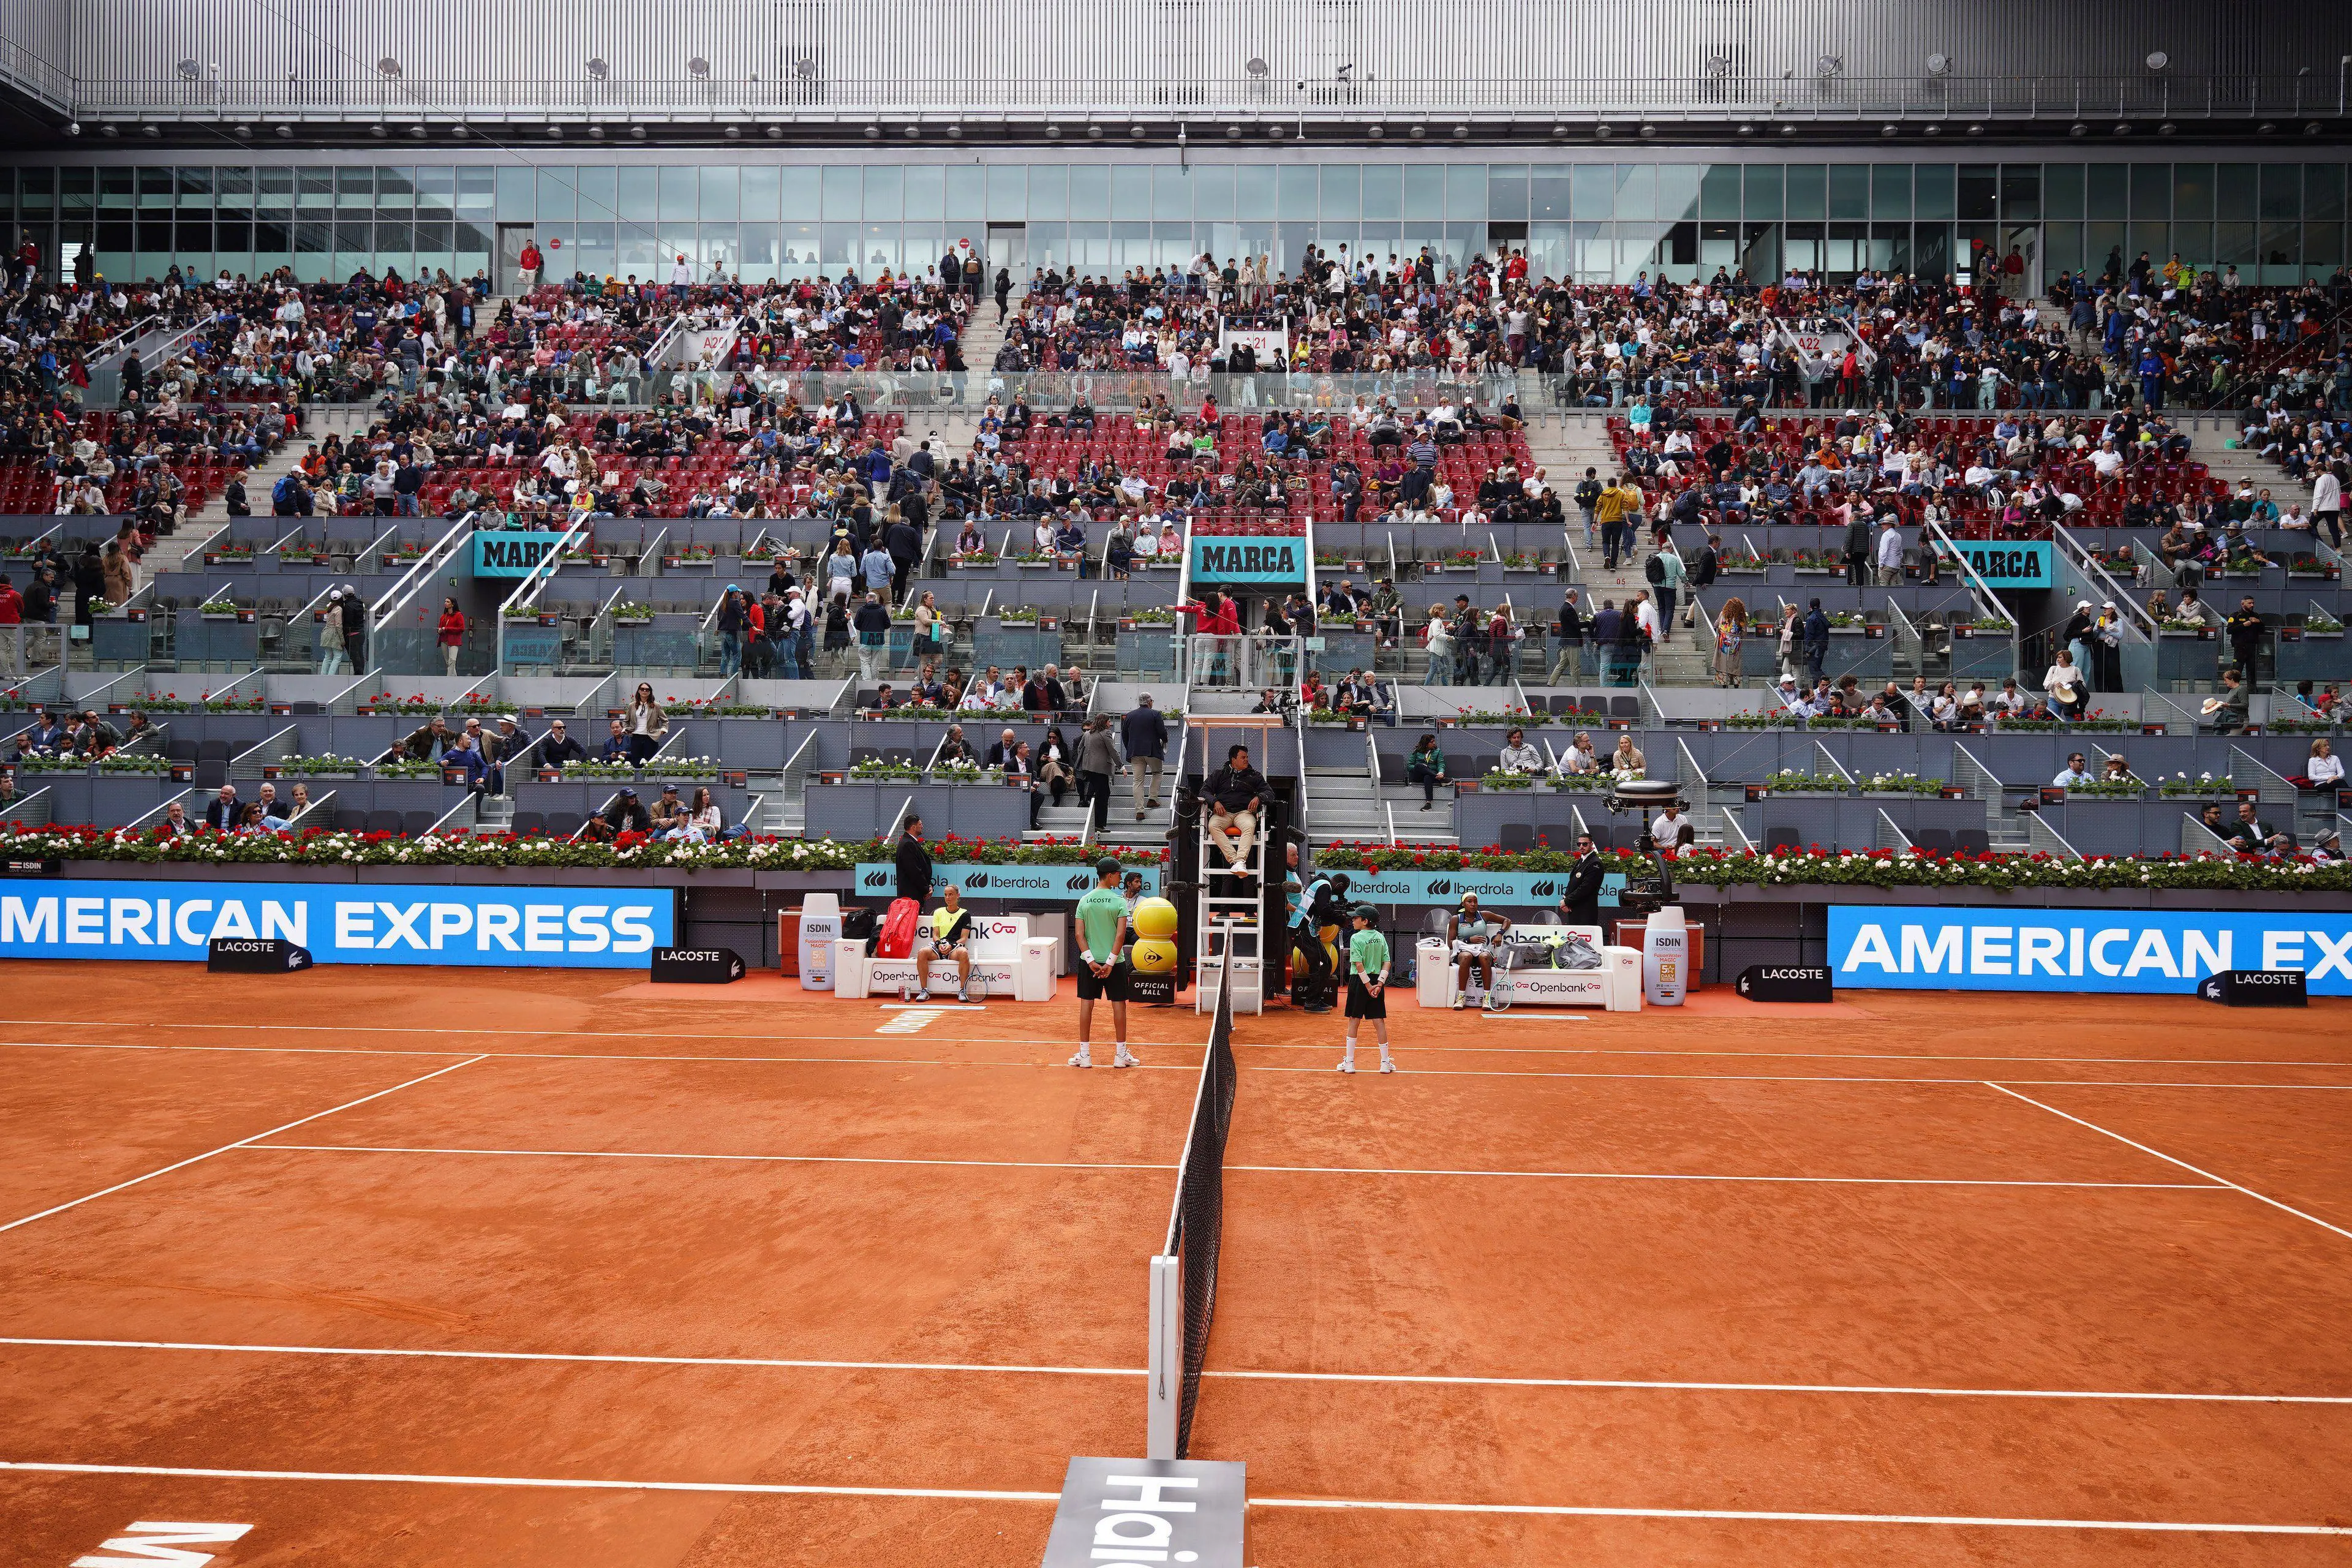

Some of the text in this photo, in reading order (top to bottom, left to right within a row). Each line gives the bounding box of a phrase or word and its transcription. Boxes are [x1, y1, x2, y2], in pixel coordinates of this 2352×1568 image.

[1799, 337, 1820, 350] A22
[1202, 546, 1295, 573] MARCA
[991, 876, 1049, 889] Iberdrola
[1351, 881, 1410, 894] Iberdrola
[1454, 882, 1513, 895] Iberdrola
[336, 902, 654, 954] EXPRESS
[807, 924, 831, 933] ISDIN
[217, 941, 275, 952] LACOSTE
[1656, 938, 1681, 947] ISDIN
[661, 951, 720, 962] LACOSTE
[1841, 924, 2352, 980] AMERICAN EX
[1662, 965, 1667, 973] 5
[1762, 968, 1823, 979] LACOSTE
[2235, 973, 2297, 985] LACOSTE
[1530, 982, 1586, 994] Openbank
[1090, 1475, 1199, 1568] Hai
